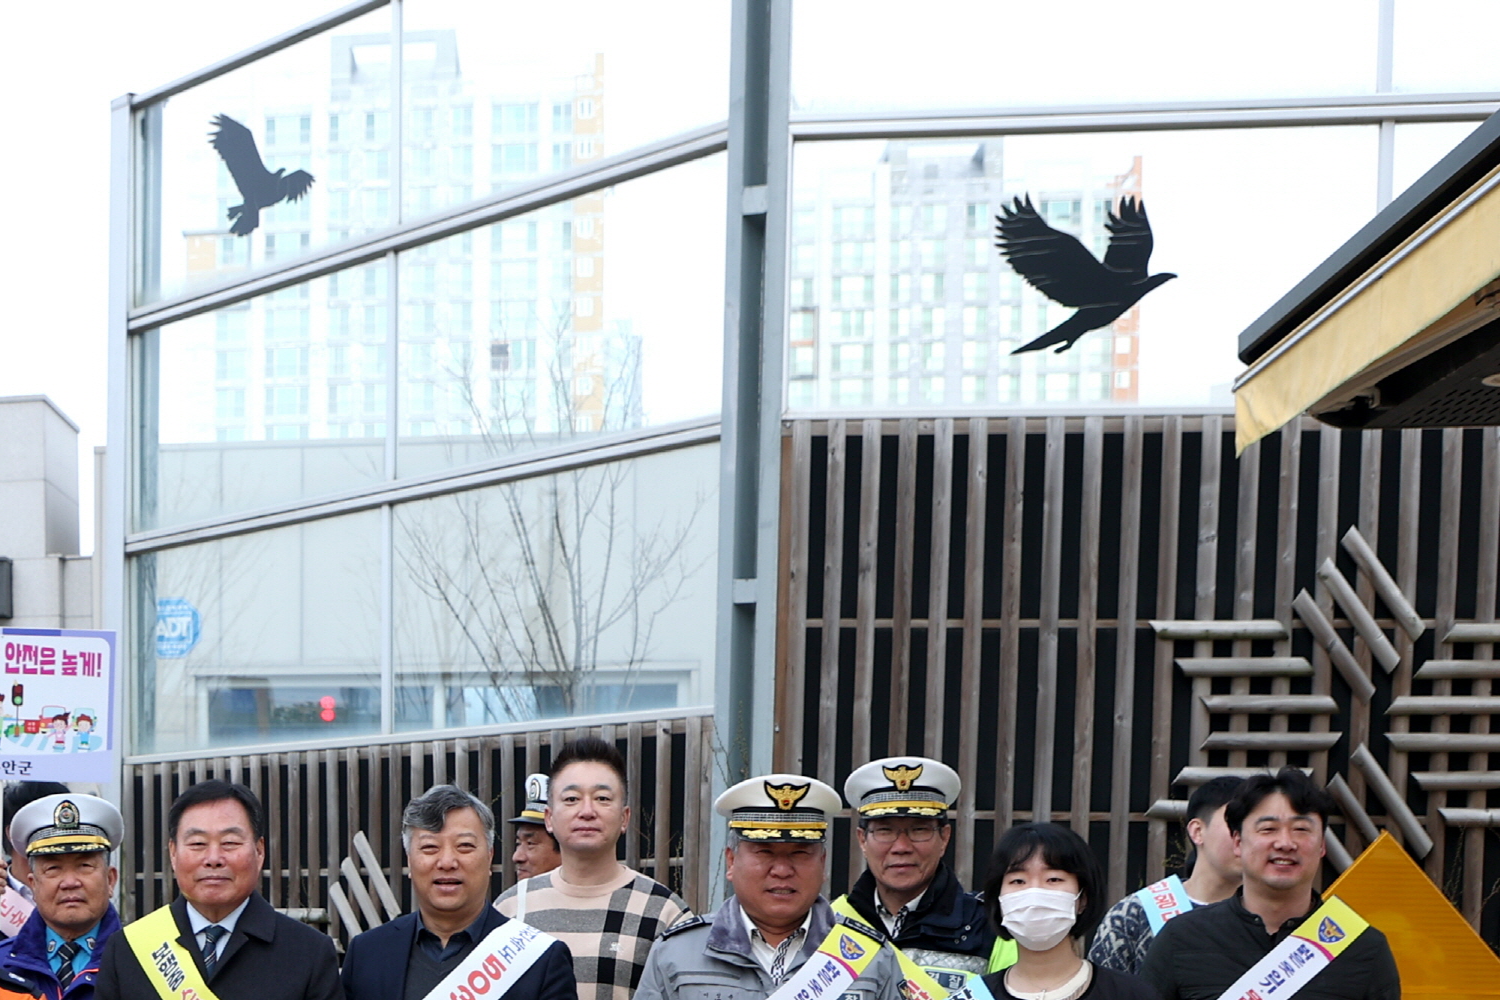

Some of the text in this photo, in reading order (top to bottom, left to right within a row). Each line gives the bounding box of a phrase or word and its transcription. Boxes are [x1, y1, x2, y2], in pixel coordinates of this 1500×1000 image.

[4, 642, 56, 676] 안전은
[61, 650, 102, 678] 높게!
[151, 940, 186, 993] 보행중
[807, 981, 823, 998] 옷
